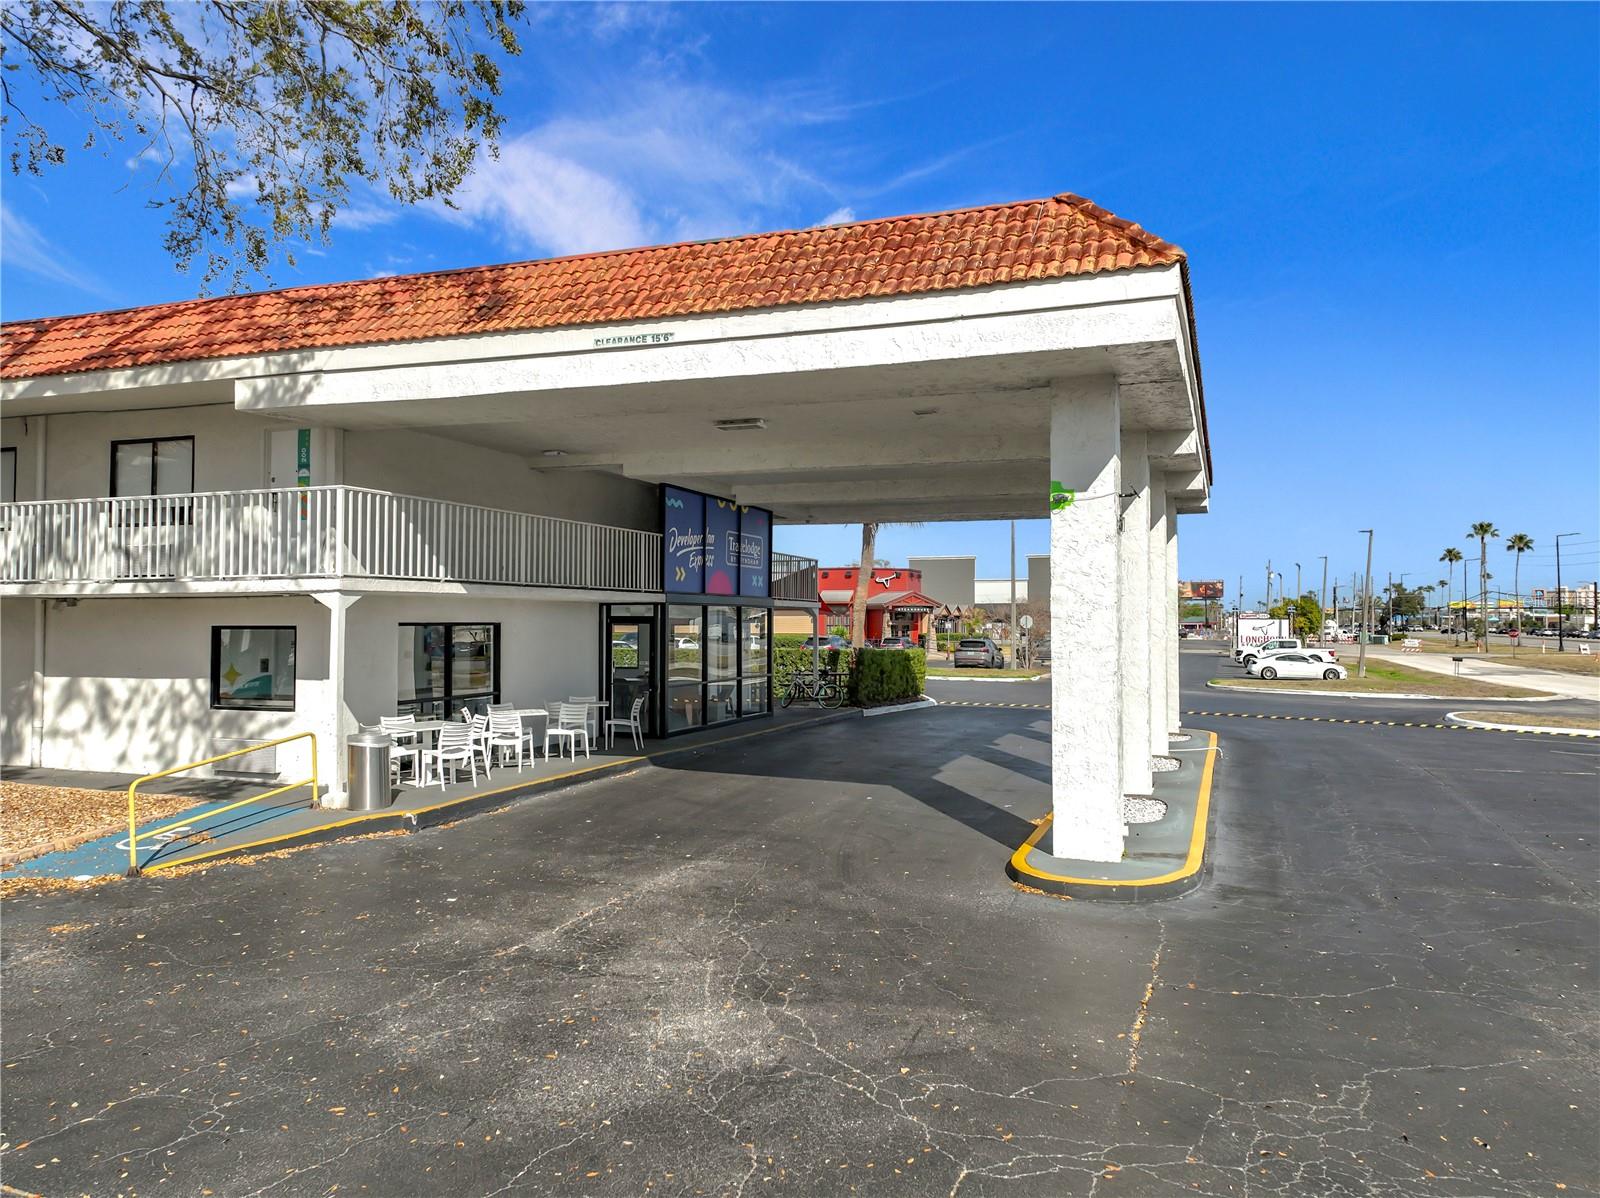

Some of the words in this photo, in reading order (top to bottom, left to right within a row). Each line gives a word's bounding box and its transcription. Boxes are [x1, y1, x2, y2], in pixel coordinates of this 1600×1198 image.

[595, 335, 648, 347] CLEARANCE
[669, 527, 703, 552] Developer
[705, 526, 715, 544] Inn
[728, 536, 760, 558] Traelodge
